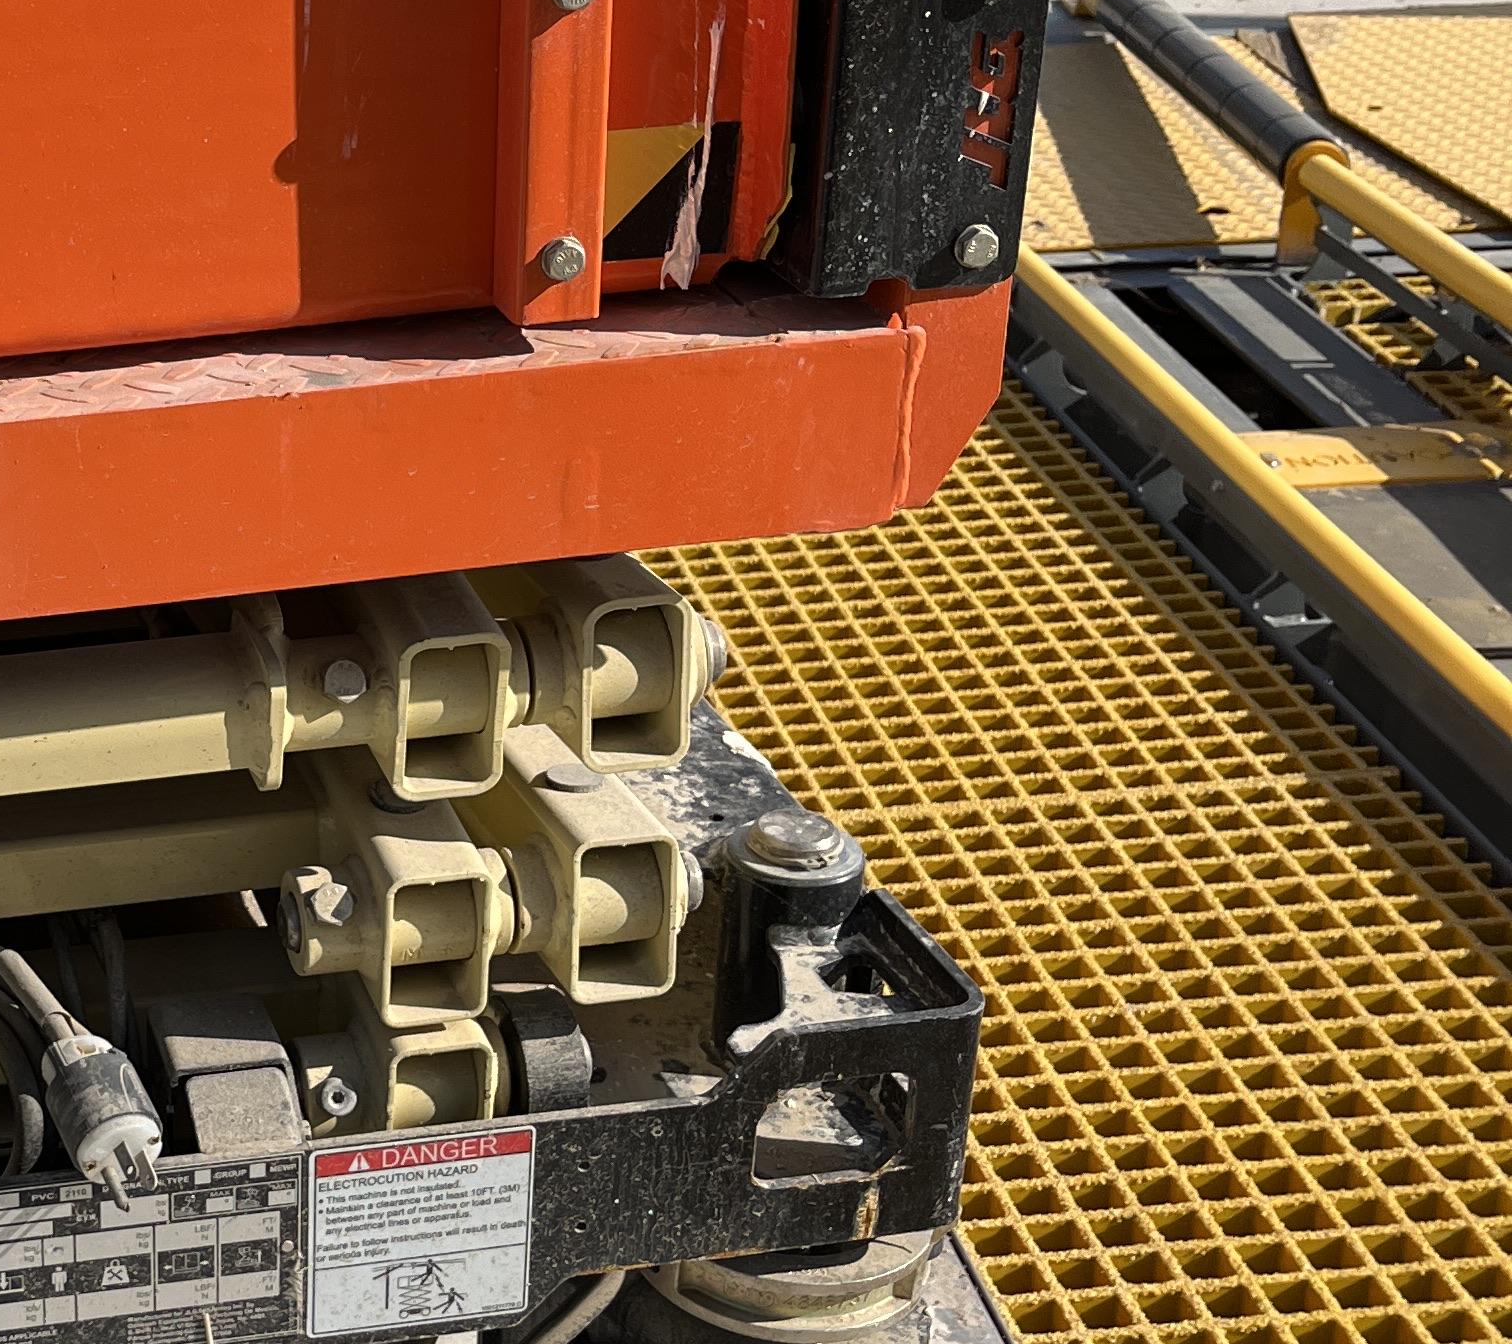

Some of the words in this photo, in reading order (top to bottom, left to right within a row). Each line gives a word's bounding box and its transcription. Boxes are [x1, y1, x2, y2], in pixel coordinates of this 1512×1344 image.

[960, 30, 1025, 191] JLG
[382, 1135, 497, 1168] DANGER
[166, 1175, 189, 1186] TYPE
[213, 1168, 247, 1179] GROUP
[318, 1170, 423, 1193] ELECTROCUTION
[427, 1163, 478, 1179] HAZARD
[209, 1189, 230, 1198] MAX
[272, 1182, 292, 1190] MAX
[325, 1194, 345, 1204] This
[348, 1188, 387, 1201] machine
[389, 1187, 397, 1196] is
[400, 1185, 415, 1195] not
[325, 1202, 365, 1215] Maintain
[367, 1202, 373, 1210] a
[375, 1195, 420, 1208] clearance
[423, 1193, 432, 1203] of
[434, 1193, 443, 1201] at
[445, 1189, 468, 1200] least
[498, 1182, 520, 1195] (3M)
[325, 1212, 364, 1225] between
[367, 1212, 384, 1221] any
[386, 1208, 404, 1219] part
[406, 1206, 416, 1214] of
[418, 1201, 457, 1213] machine
[471, 1196, 491, 1207] load
[493, 1194, 511, 1204] and
[316, 1240, 348, 1253] Failure
[350, 1239, 359, 1248] to
[361, 1235, 388, 1246] follow
[390, 1228, 442, 1243] instructions
[445, 1227, 459, 1236] will
[461, 1223, 487, 1234] result
[489, 1222, 497, 1230] in
[500, 1218, 526, 1229] death
[325, 1227, 342, 1237] any
[344, 1220, 385, 1232] electrical
[388, 1217, 409, 1227] lines
[328, 1249, 361, 1261] serious
[8, 1328, 58, 1341] APPLICABLE
